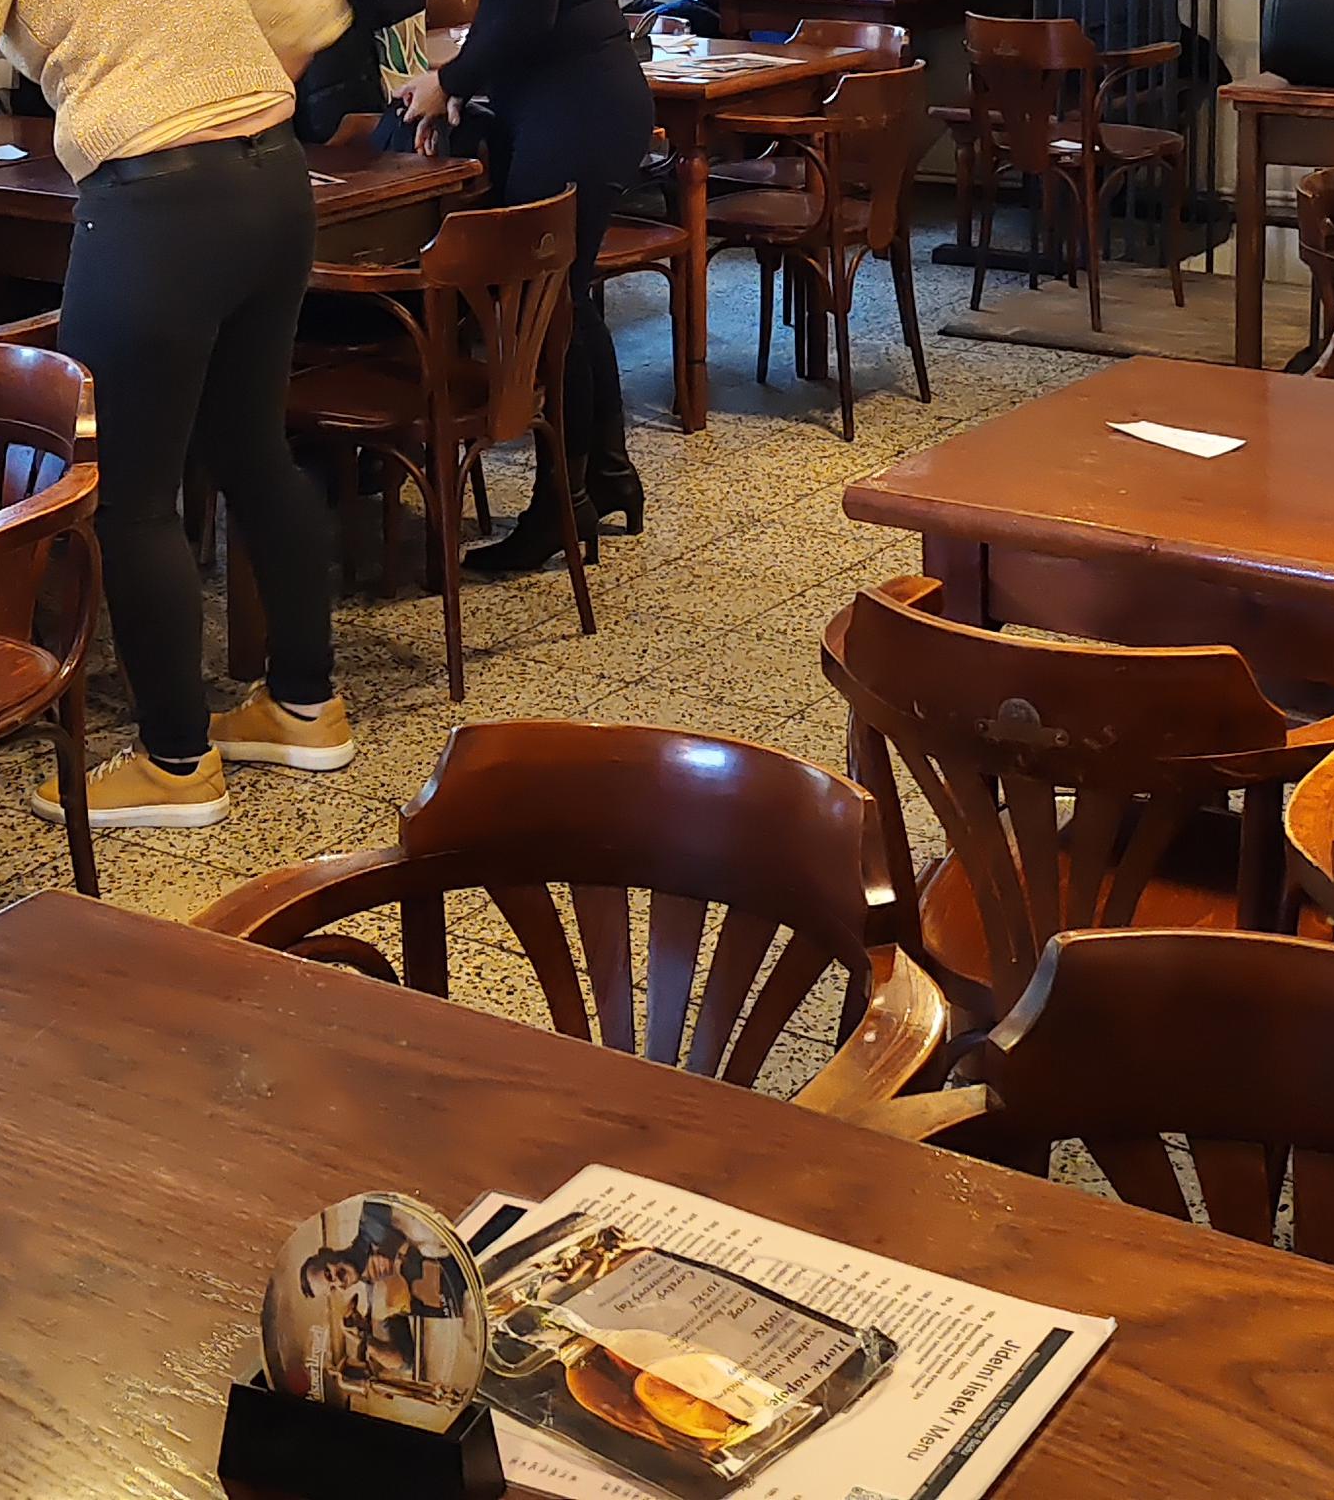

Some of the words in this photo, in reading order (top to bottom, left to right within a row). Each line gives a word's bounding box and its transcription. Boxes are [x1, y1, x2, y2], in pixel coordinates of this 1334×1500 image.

[810, 1337, 851, 1375] Horké
[769, 1373, 812, 1407] nápoje
[907, 1423, 950, 1461] Menu
